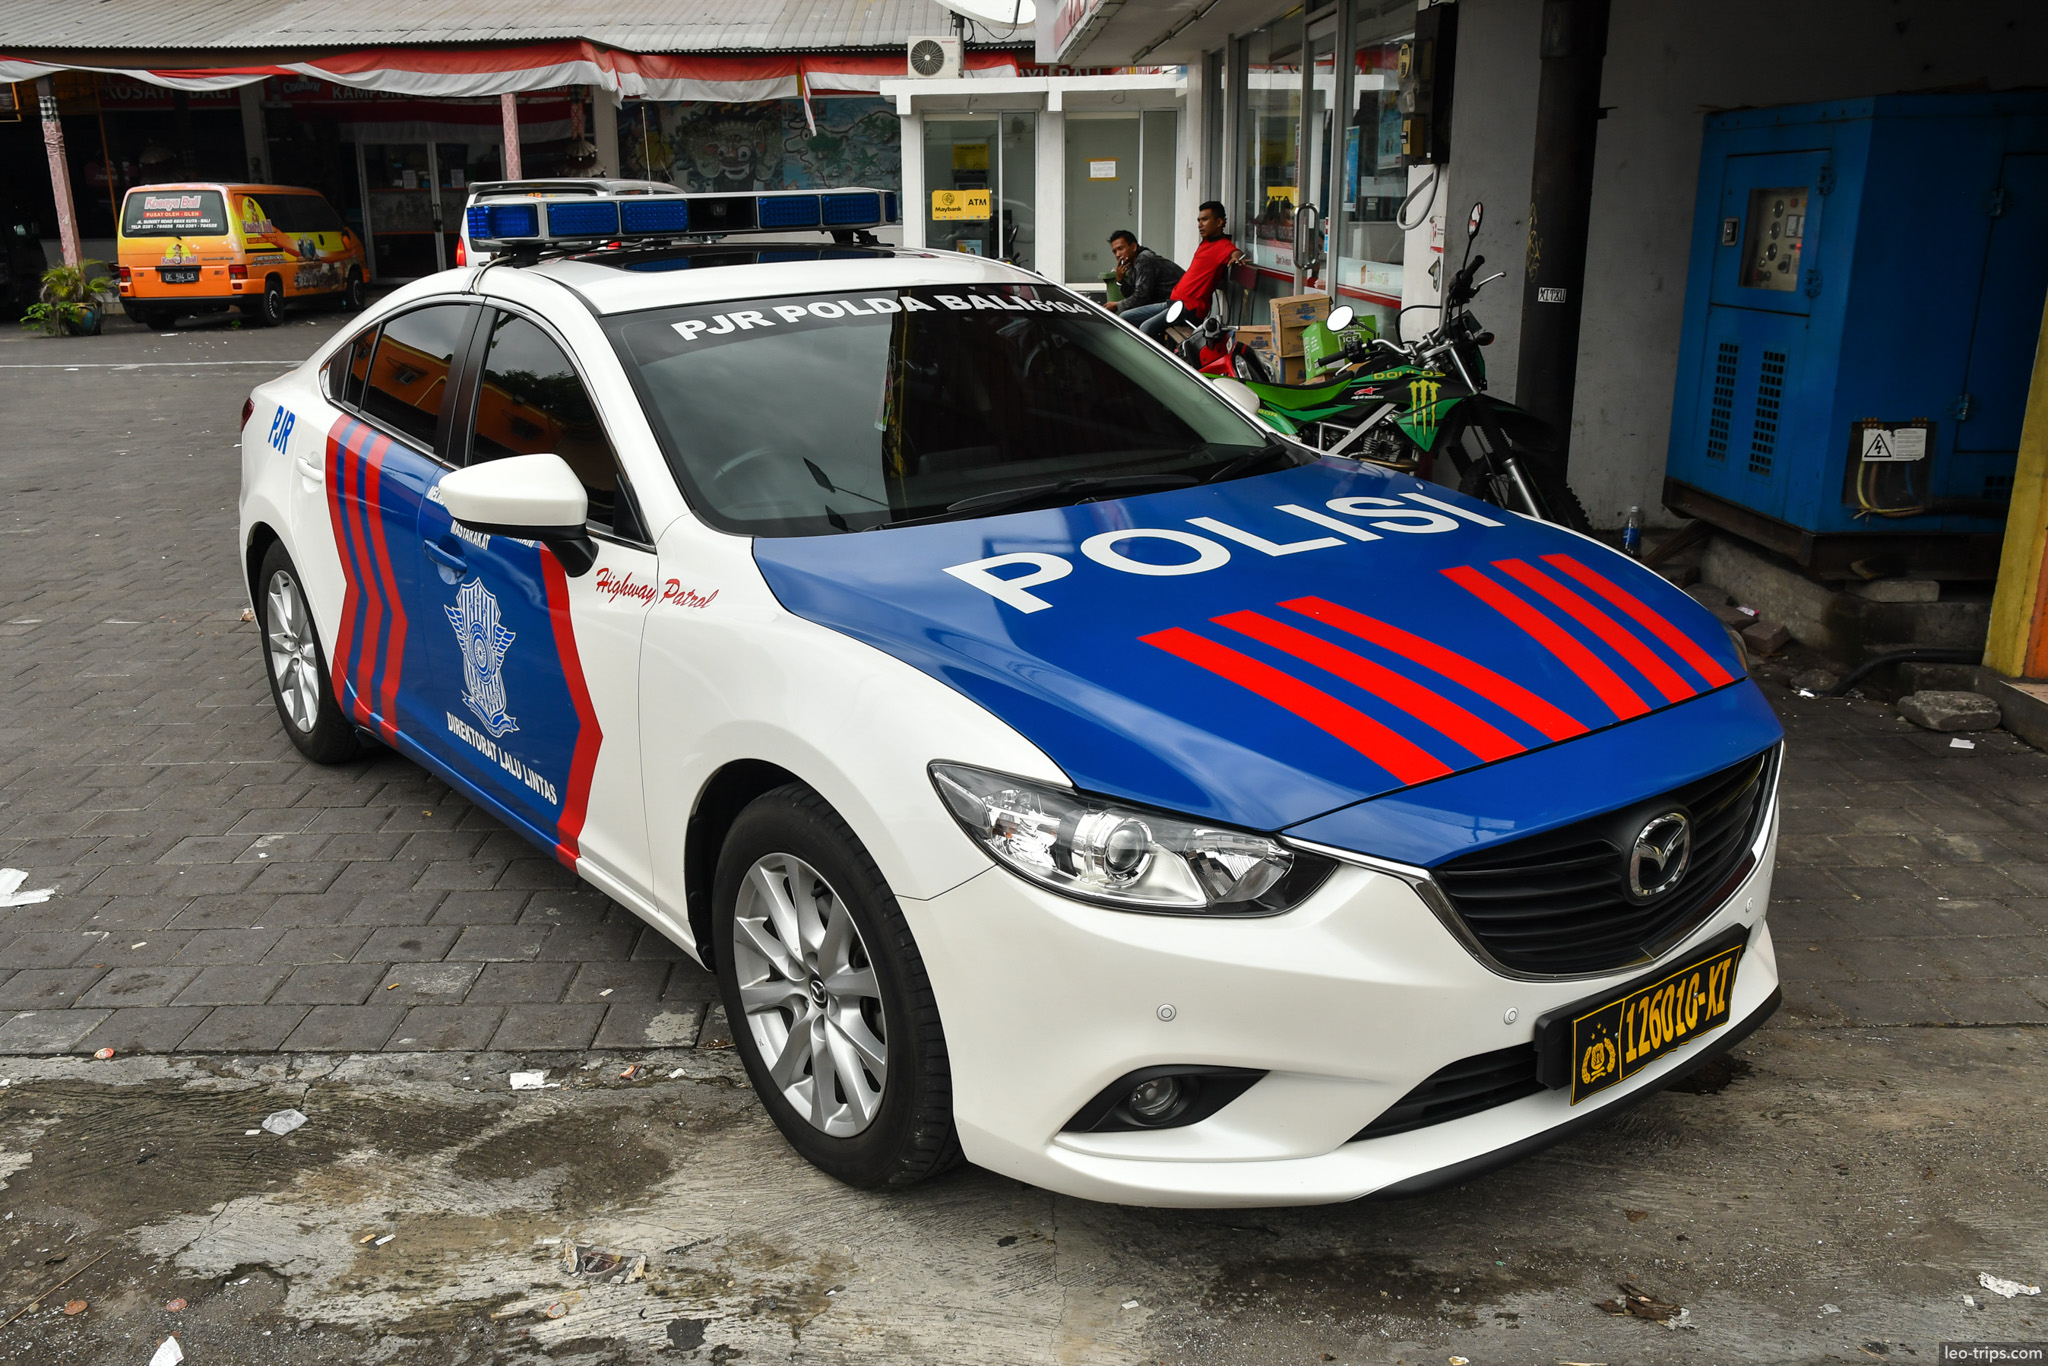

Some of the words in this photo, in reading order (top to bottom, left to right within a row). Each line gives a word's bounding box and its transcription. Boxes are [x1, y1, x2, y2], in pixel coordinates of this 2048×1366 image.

[144, 197, 180, 211] Kosayu
[180, 195, 202, 209] Bali
[670, 309, 776, 342] PJR
[772, 296, 936, 324] POLDA
[933, 293, 1036, 311] BALI
[1029, 300, 1093, 316] 6104
[1342, 335, 1358, 343] ICE
[267, 405, 296, 455] PJR
[942, 492, 1505, 614] POLISI
[596, 567, 657, 608] Highway
[658, 578, 719, 608] Patrol
[446, 711, 498, 763] DIREKTORAT
[498, 746, 522, 781] LALU
[522, 764, 558, 806] LINTAS
